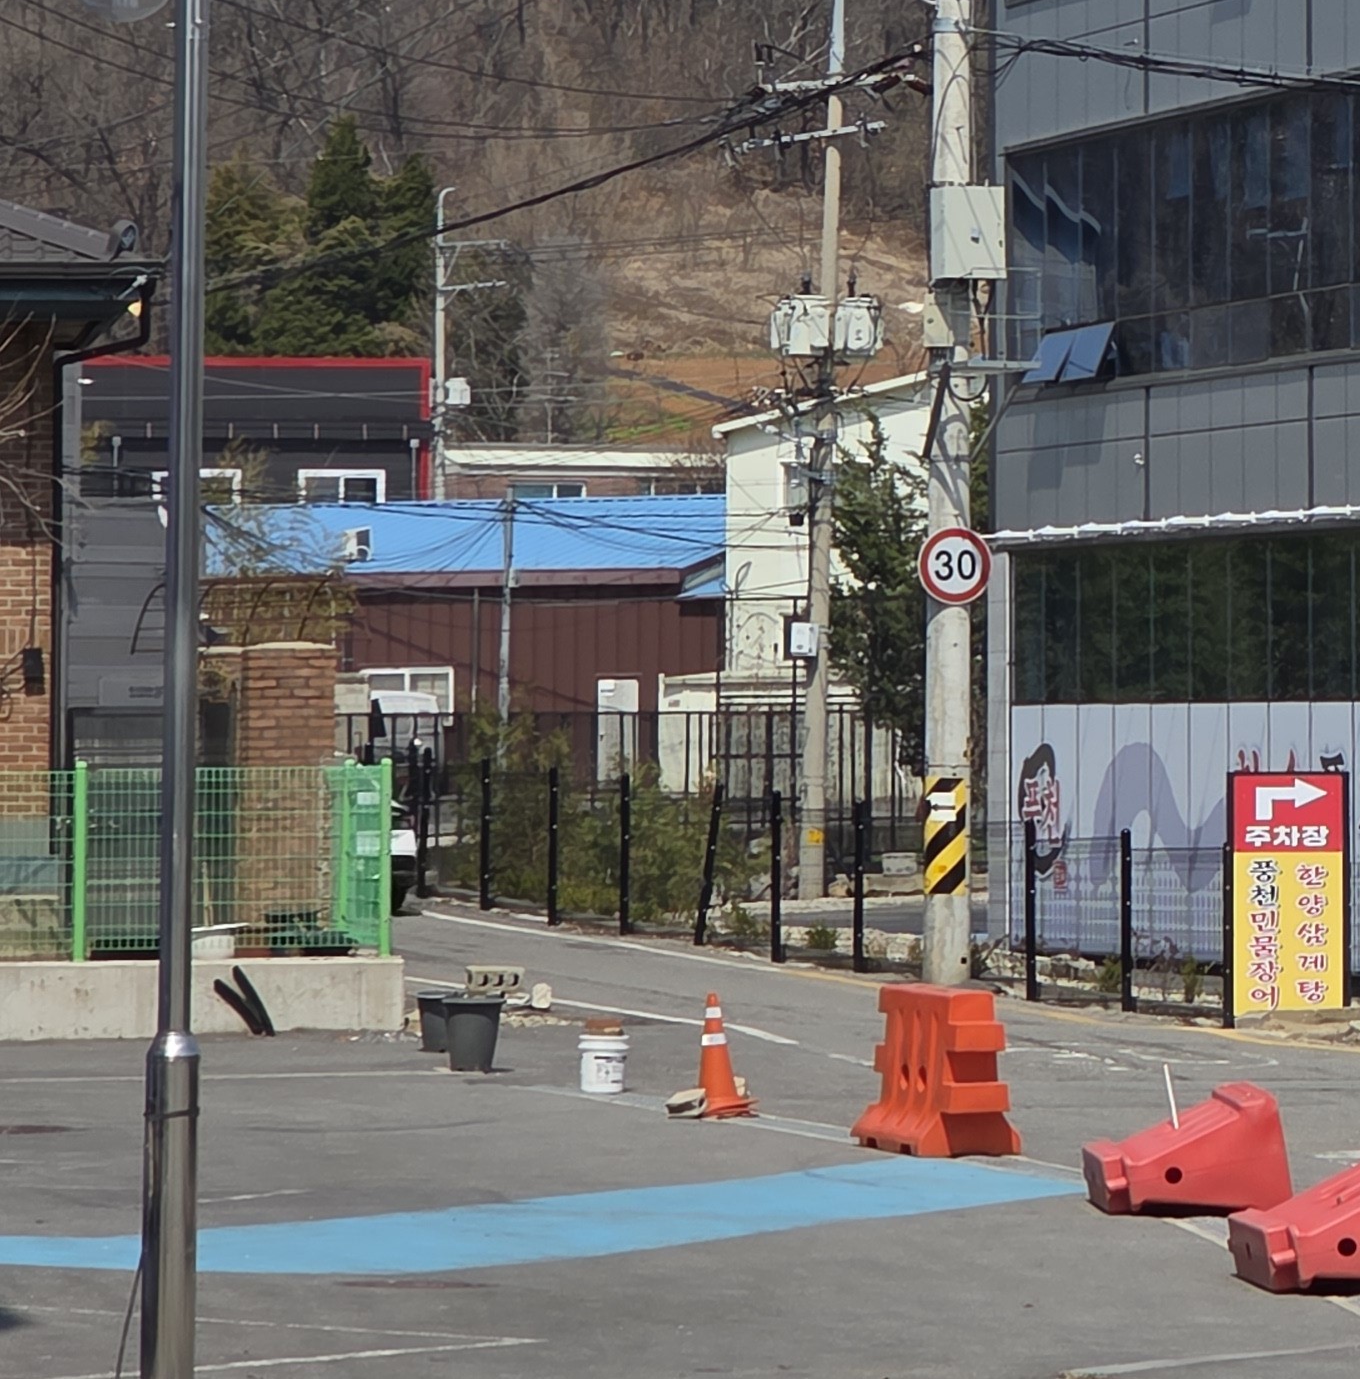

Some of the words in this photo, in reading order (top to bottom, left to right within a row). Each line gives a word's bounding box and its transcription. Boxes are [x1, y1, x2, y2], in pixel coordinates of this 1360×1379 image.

[933, 549, 977, 582] 30
[1244, 825, 1330, 847] 주차장
[1249, 859, 1282, 1009] 풍천민물장어
[1296, 864, 1330, 1004] 한양삼계탕
